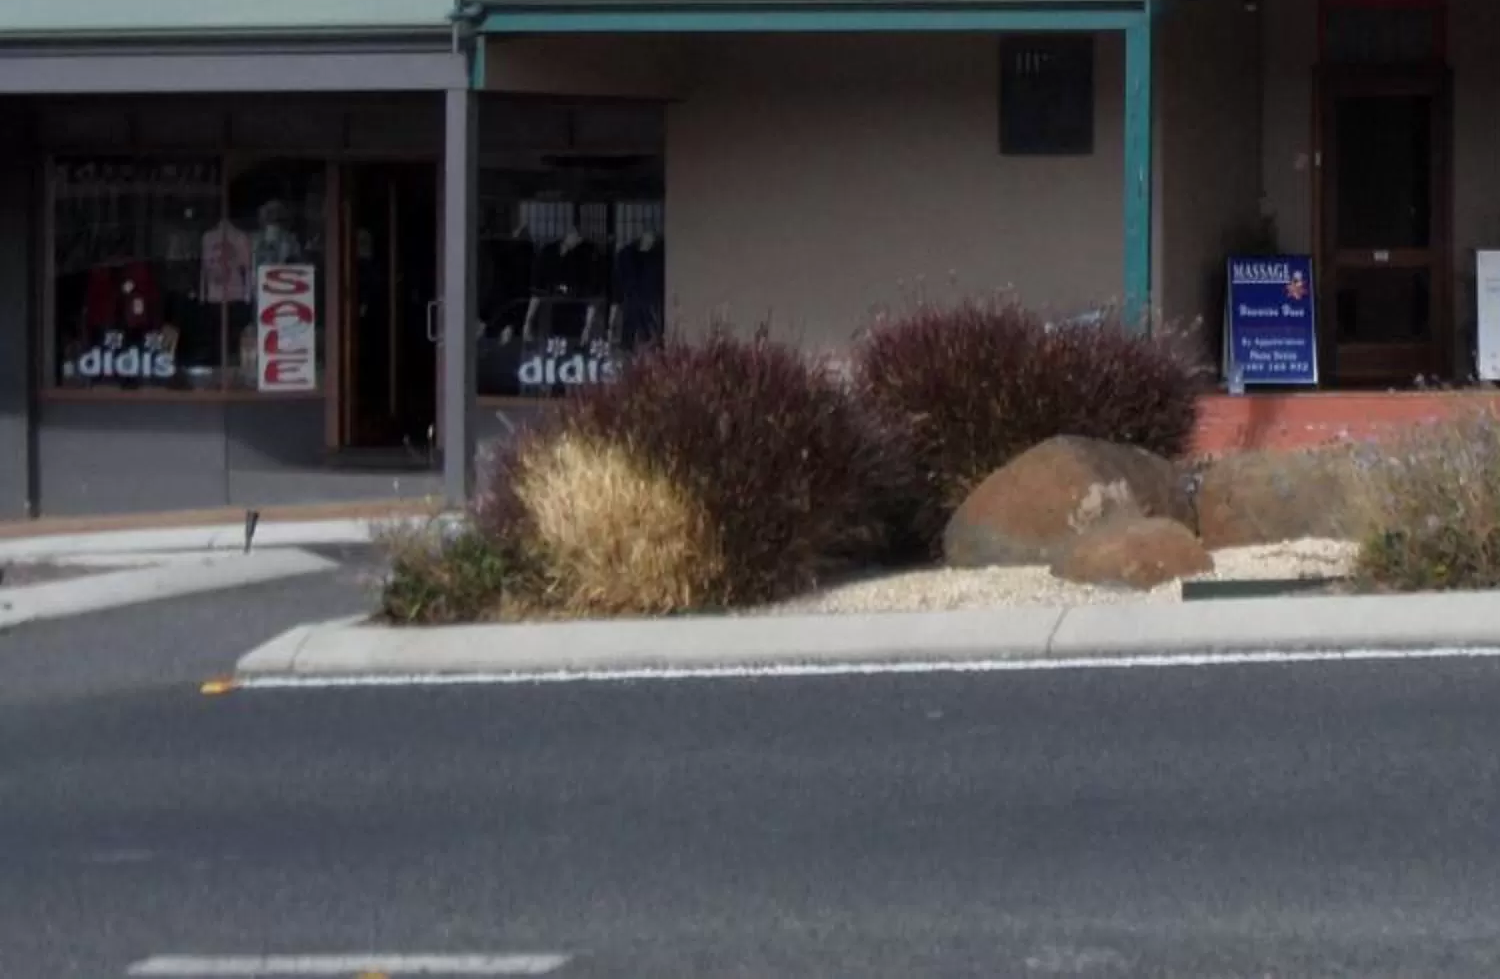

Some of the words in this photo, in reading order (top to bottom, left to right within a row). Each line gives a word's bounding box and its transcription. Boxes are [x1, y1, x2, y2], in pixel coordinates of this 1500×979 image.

[1233, 263, 1289, 280] MASSAGE
[261, 270, 313, 385] SALE
[79, 330, 176, 377] didis
